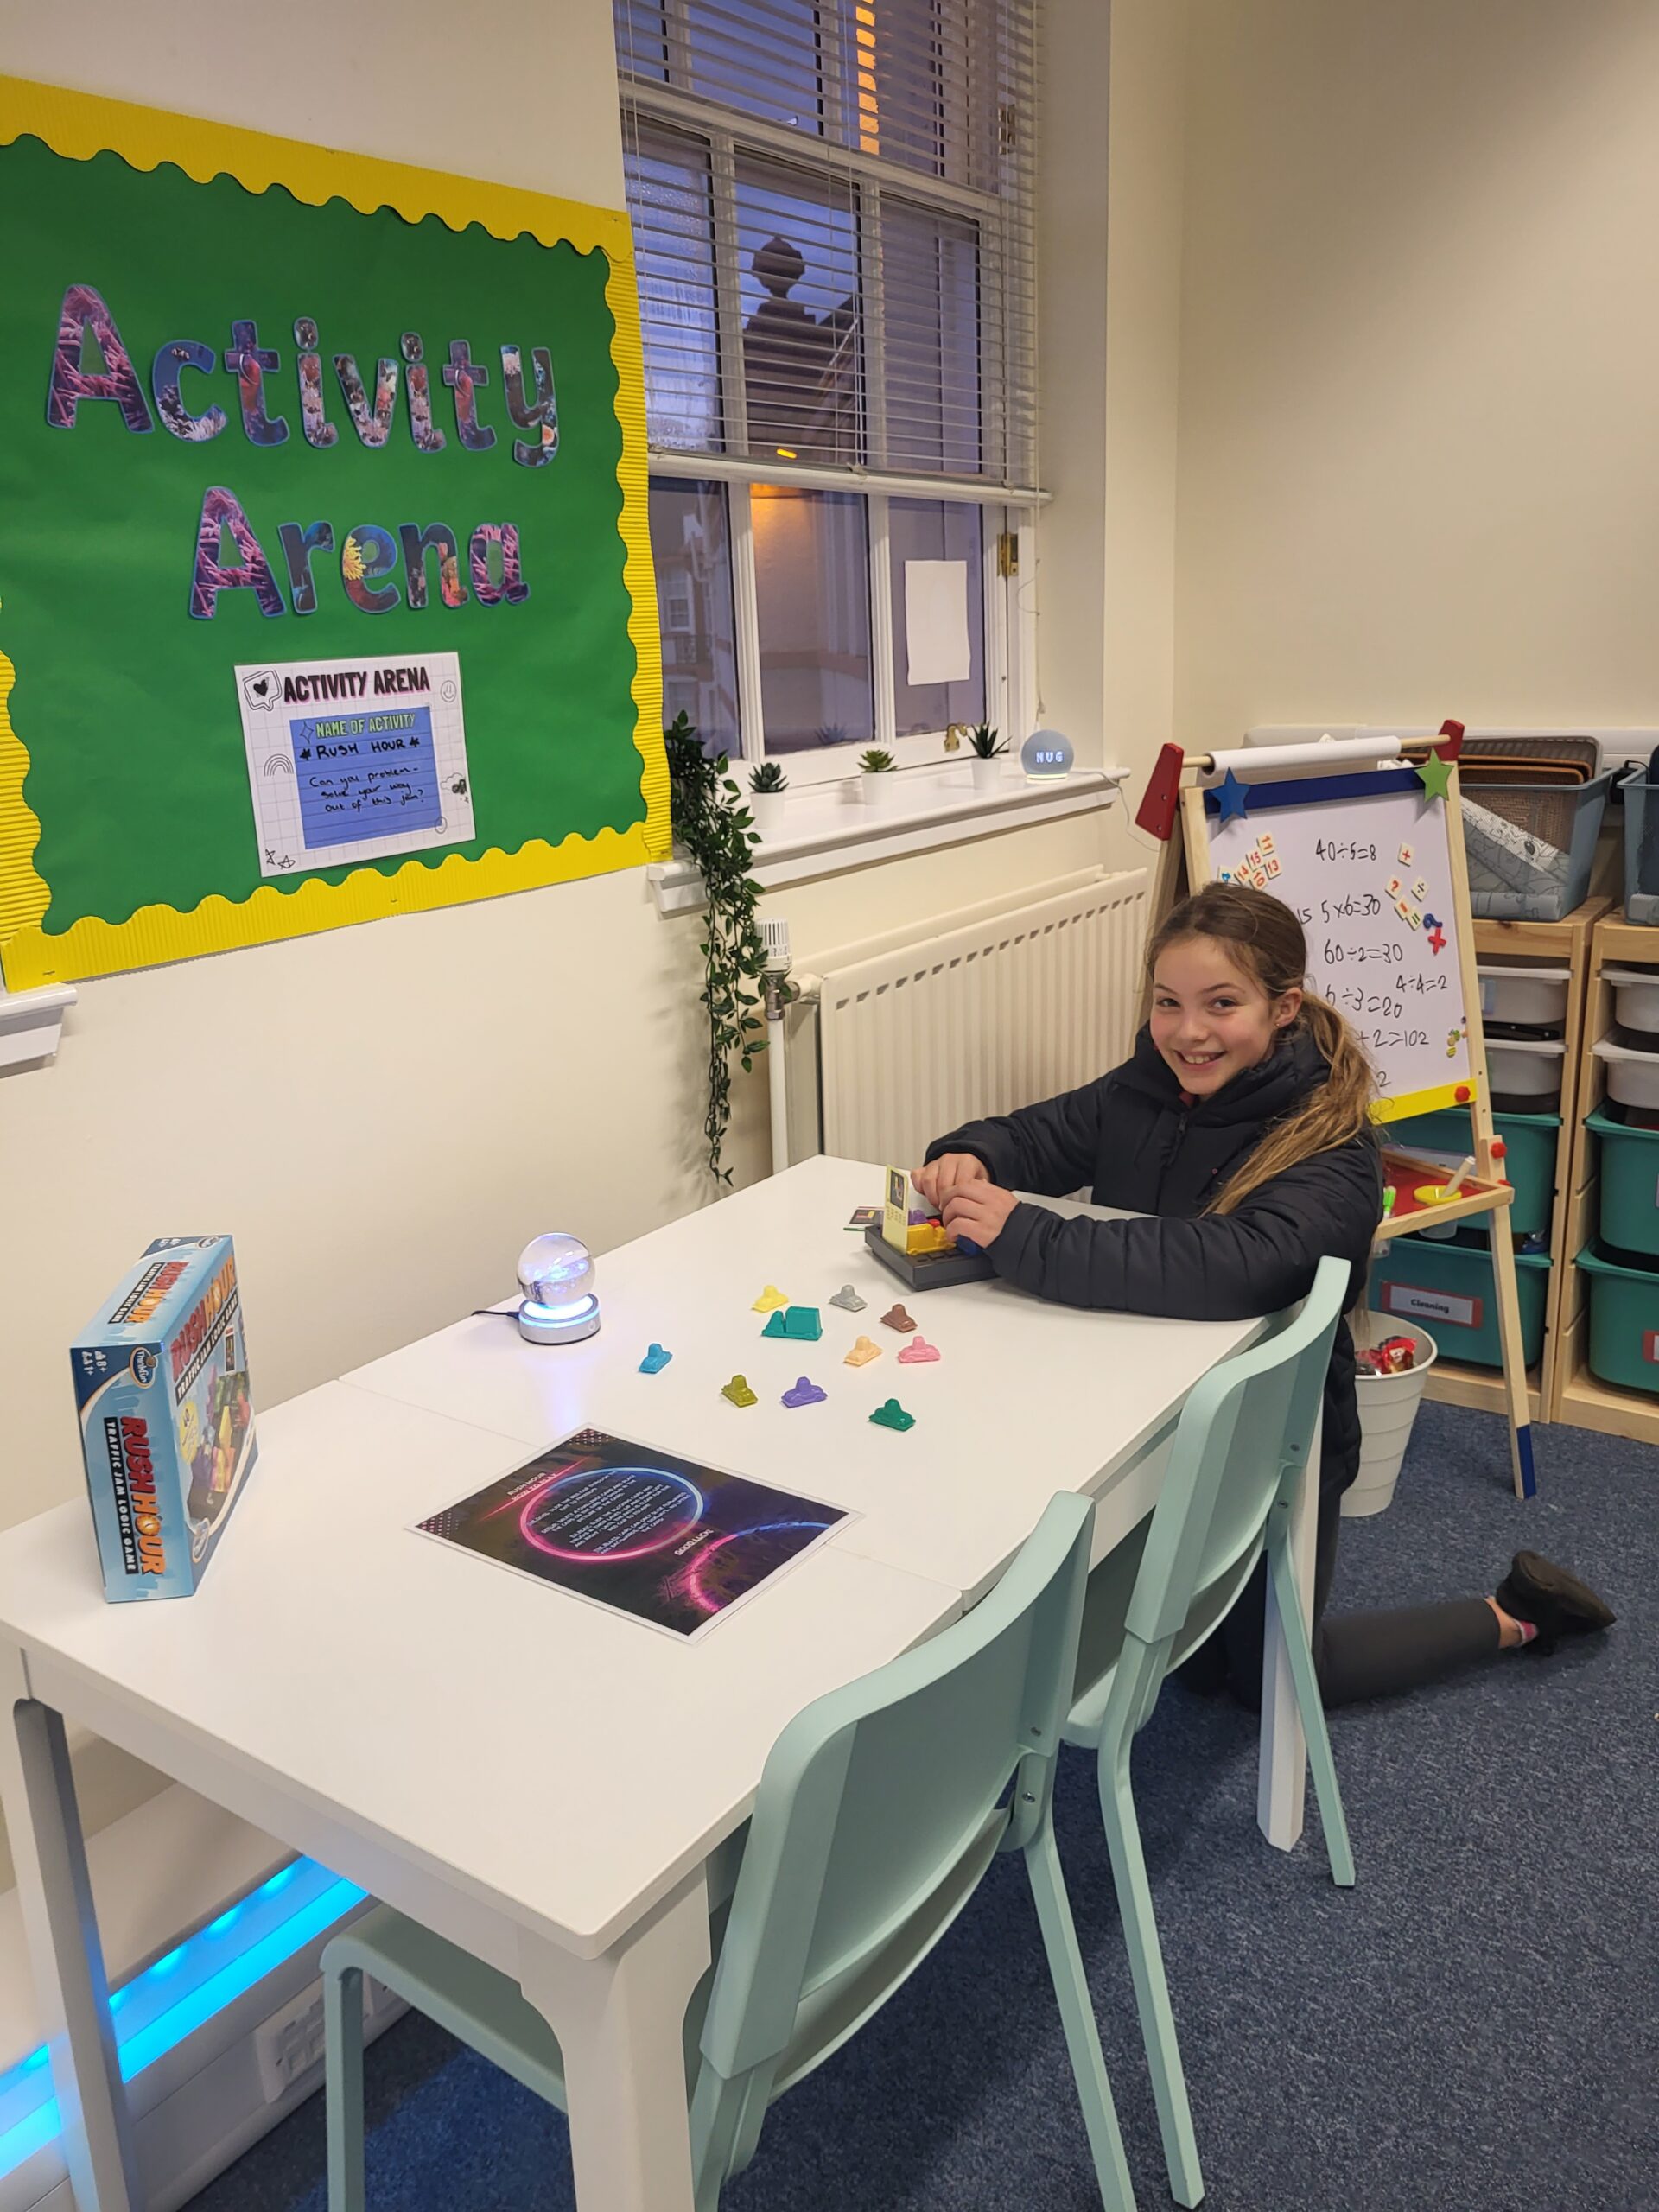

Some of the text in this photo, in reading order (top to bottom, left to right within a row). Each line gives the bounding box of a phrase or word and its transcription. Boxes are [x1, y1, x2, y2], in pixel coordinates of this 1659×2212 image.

[47, 284, 557, 467] Activity
[189, 486, 531, 620] Arena
[284, 667, 430, 703] ACTIVITY ARENA
[315, 713, 415, 739] NAME OF ACTIVITY
[317, 741, 405, 759] RUSH HOUR
[309, 777, 333, 788] Can
[340, 775, 360, 789] you
[390, 783, 410, 797] way
[326, 802, 345, 812] out
[352, 799, 362, 813] of
[372, 795, 391, 805] this
[1261, 835, 1273, 850] 11
[1250, 851, 1261, 866] 15
[1268, 859, 1279, 874] 13
[1237, 865, 1249, 880] 14
[1253, 872, 1265, 887] 10
[1410, 1299, 1450, 1313] Cleaning
[170, 1300, 207, 1382] RUSH
[204, 1256, 236, 1328] HOUR
[177, 1357, 200, 1399] TRAFFIC
[199, 1342, 212, 1368] JAM
[211, 1319, 226, 1344] LOGIC
[225, 1294, 238, 1324] GAME
[105, 1421, 136, 1572] TRAFFIC JAM LOGIC GAME
[120, 1416, 166, 1575] RUSH HOUR
